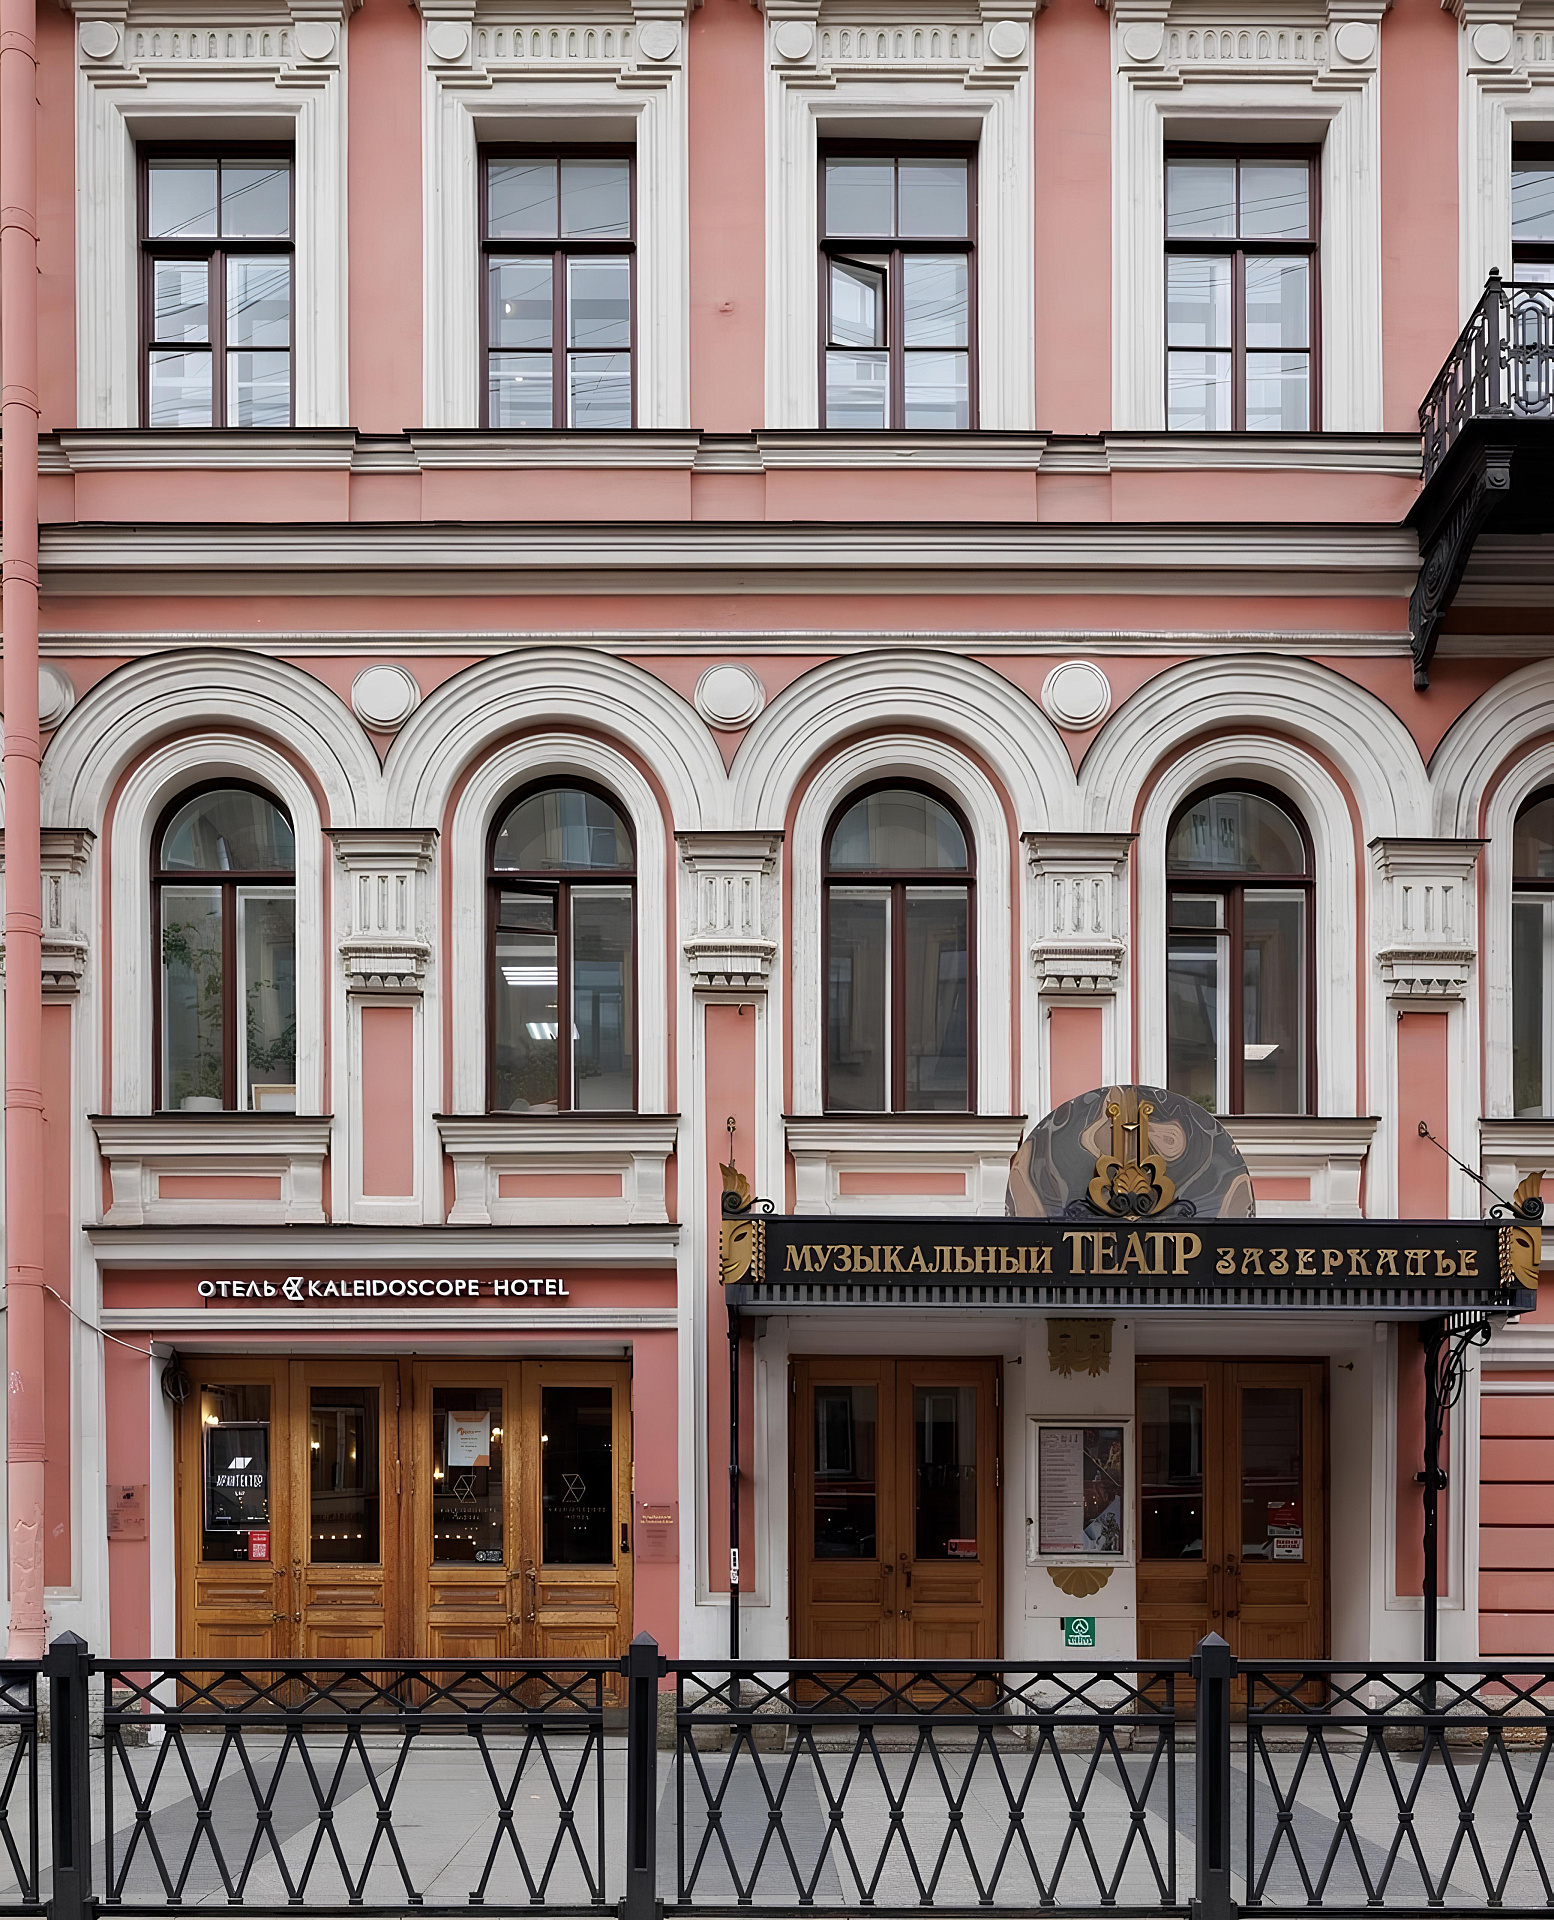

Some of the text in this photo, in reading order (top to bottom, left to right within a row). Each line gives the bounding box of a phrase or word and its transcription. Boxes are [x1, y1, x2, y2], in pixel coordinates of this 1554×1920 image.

[1062, 1231, 1202, 1275] ТЕАТР
[1215, 1247, 1479, 1277] ЗАЗЕРКАЛЬЕ
[197, 1280, 276, 1297] ОТЕЛЬ
[308, 1279, 570, 1297] KALEIDOSCOPE HOTEL
